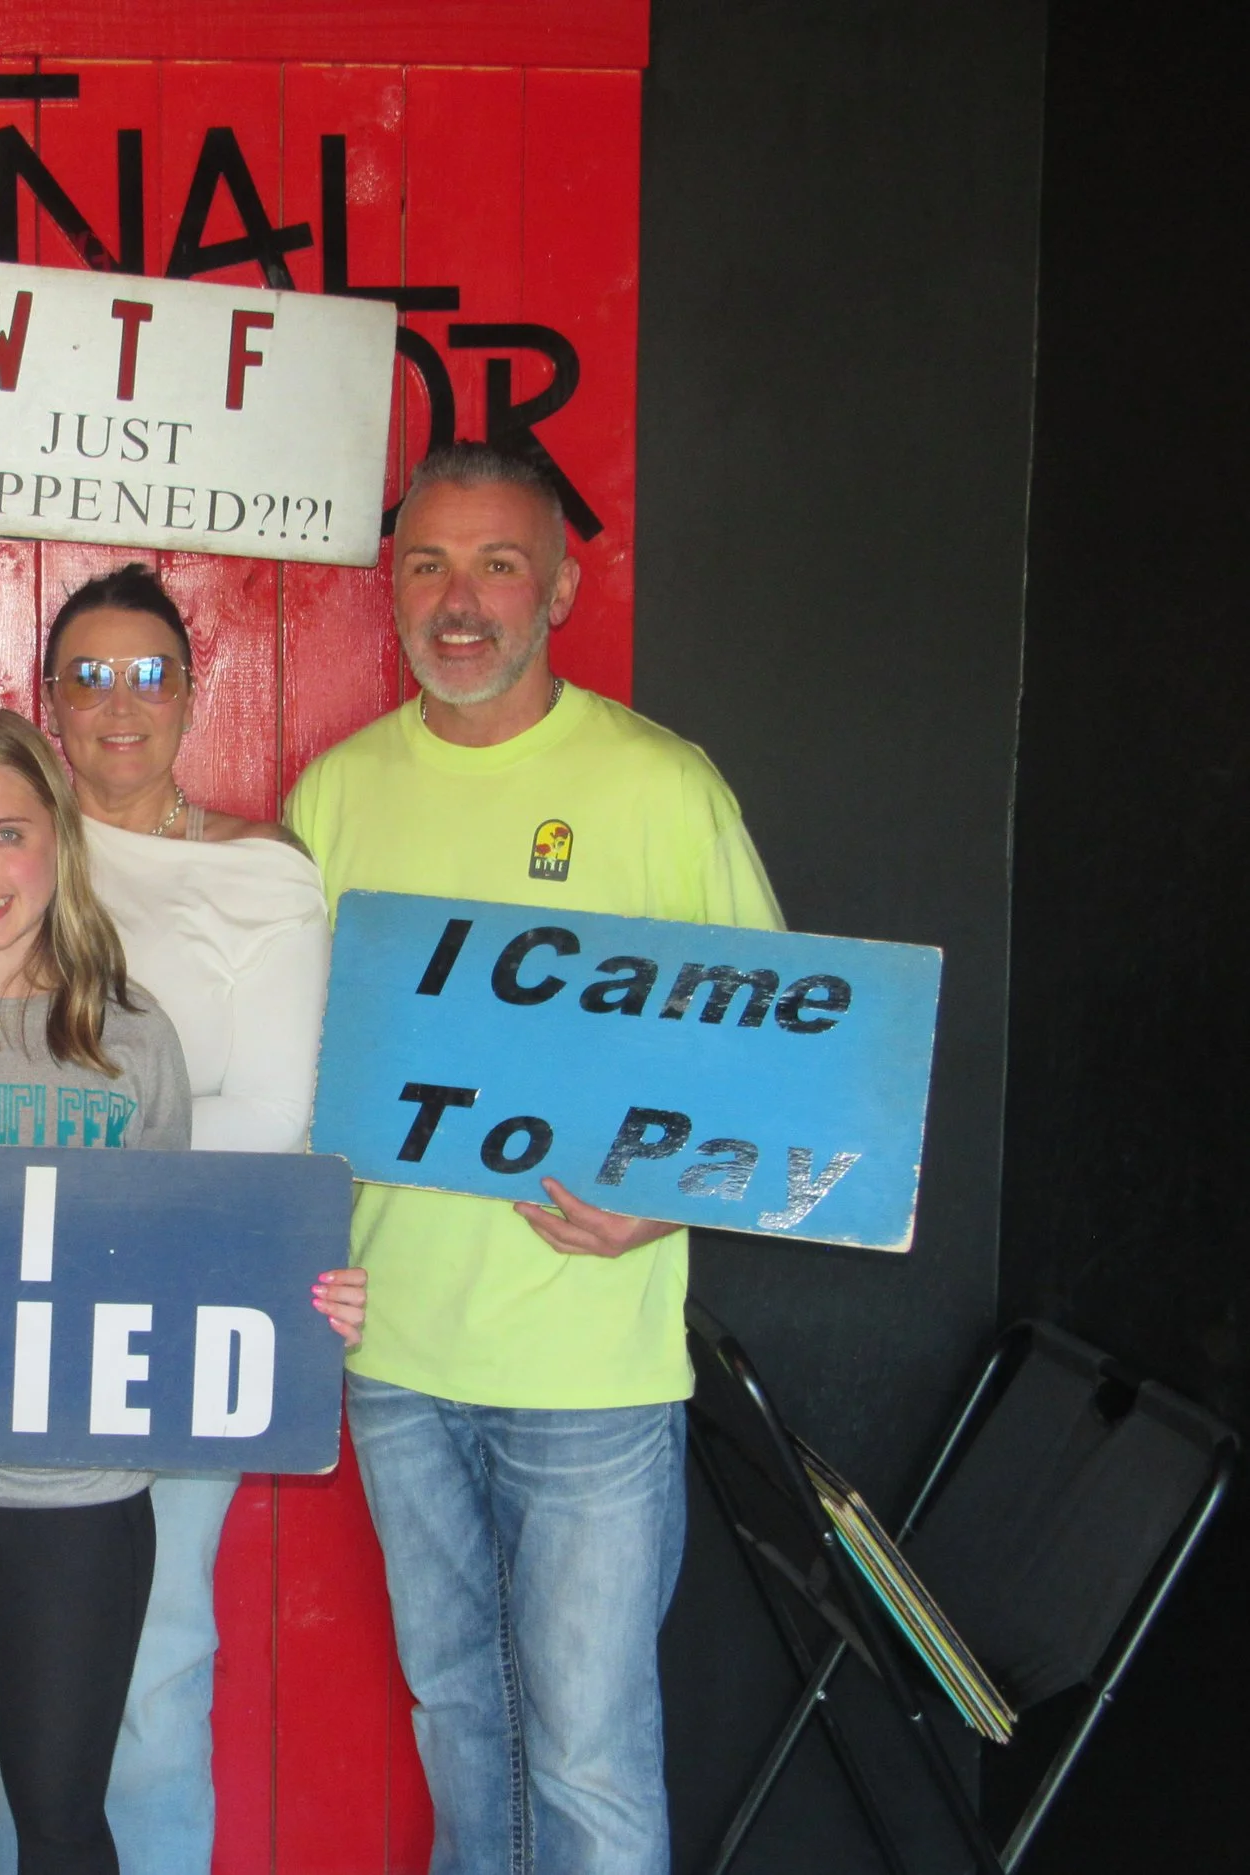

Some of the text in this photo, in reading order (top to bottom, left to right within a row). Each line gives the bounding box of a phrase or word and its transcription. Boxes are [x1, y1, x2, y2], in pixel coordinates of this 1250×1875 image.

[40, 411, 192, 466] JUST
[415, 918, 852, 1035] I Came
[396, 1081, 862, 1231] To Pay
[19, 1165, 57, 1282] I
